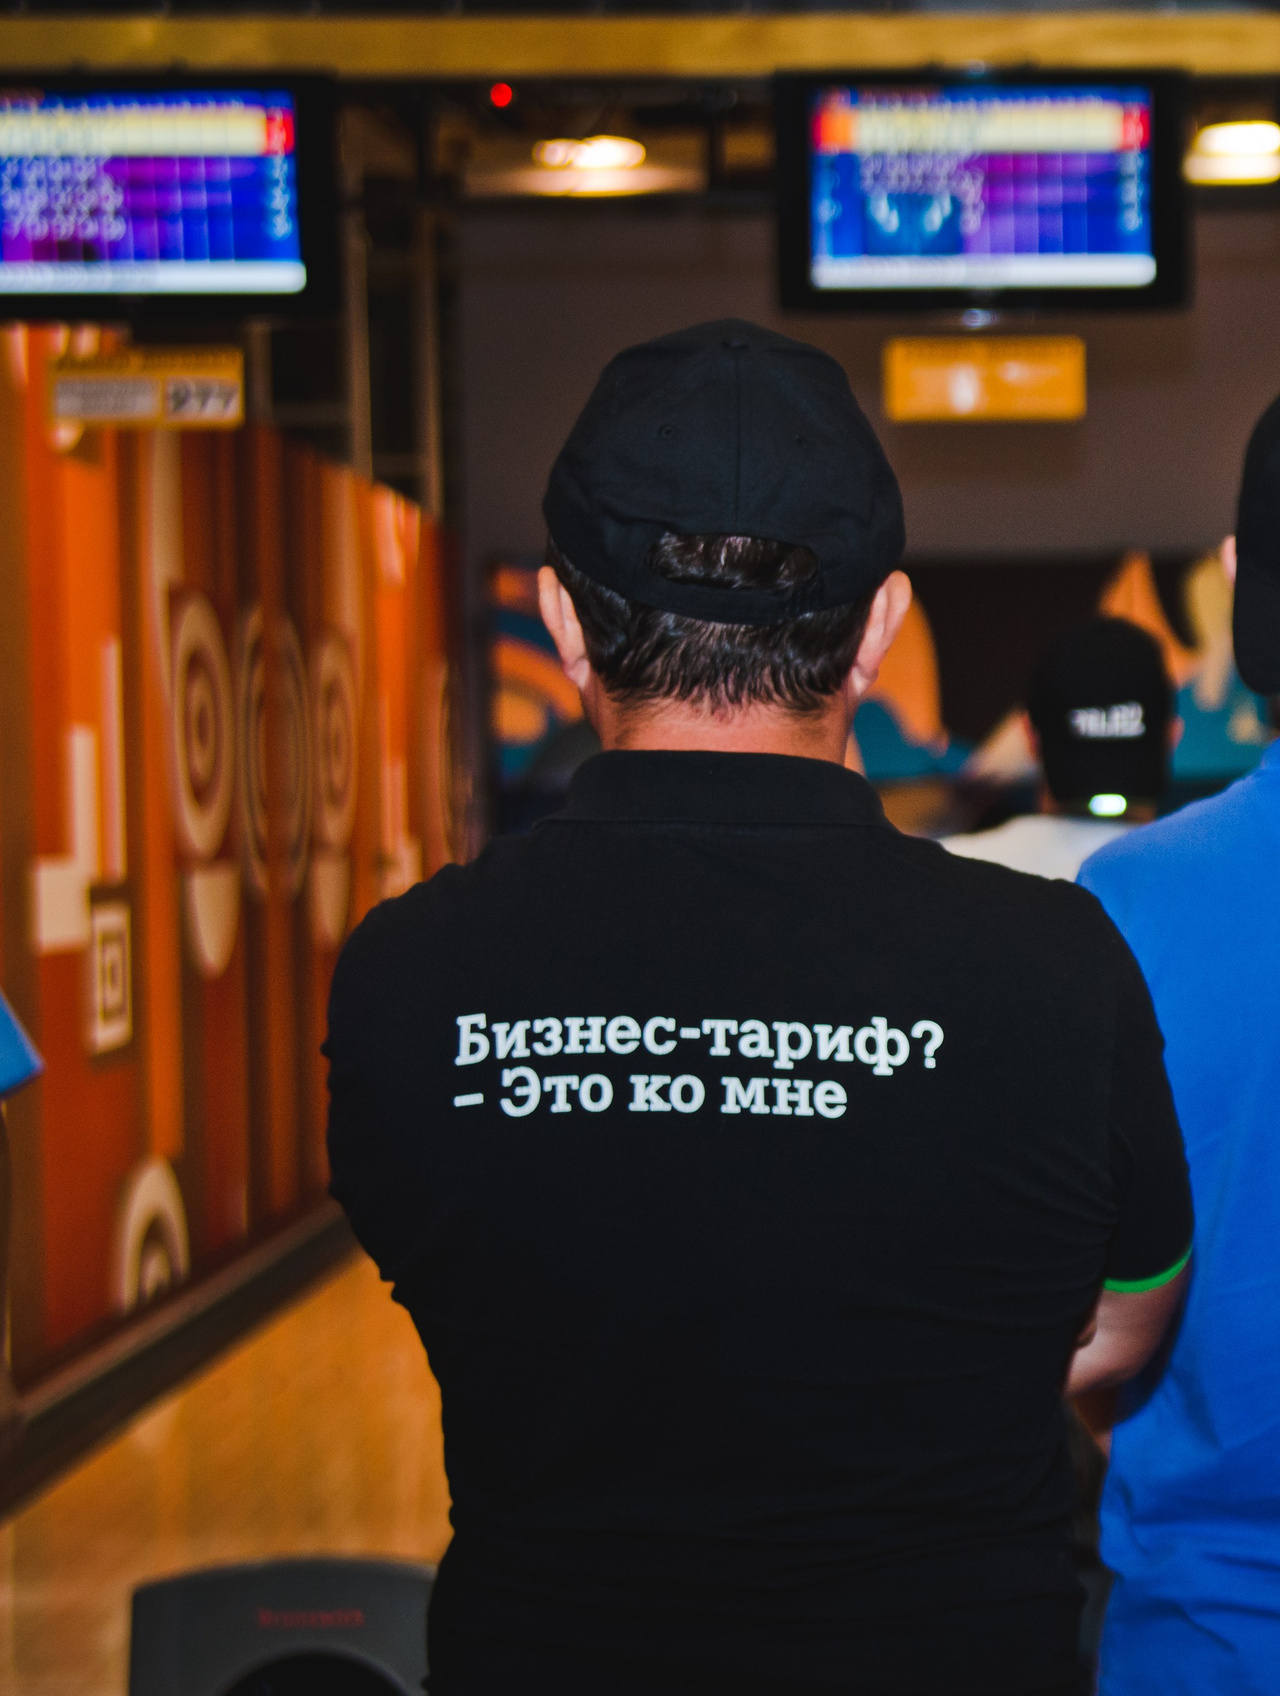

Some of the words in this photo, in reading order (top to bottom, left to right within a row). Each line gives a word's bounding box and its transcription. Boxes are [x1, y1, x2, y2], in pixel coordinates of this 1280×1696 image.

[453, 1012, 945, 1077] Бизнес-тариф?
[499, 1065, 615, 1119] Это
[628, 1074, 706, 1114] ко
[720, 1076, 849, 1119] мне
